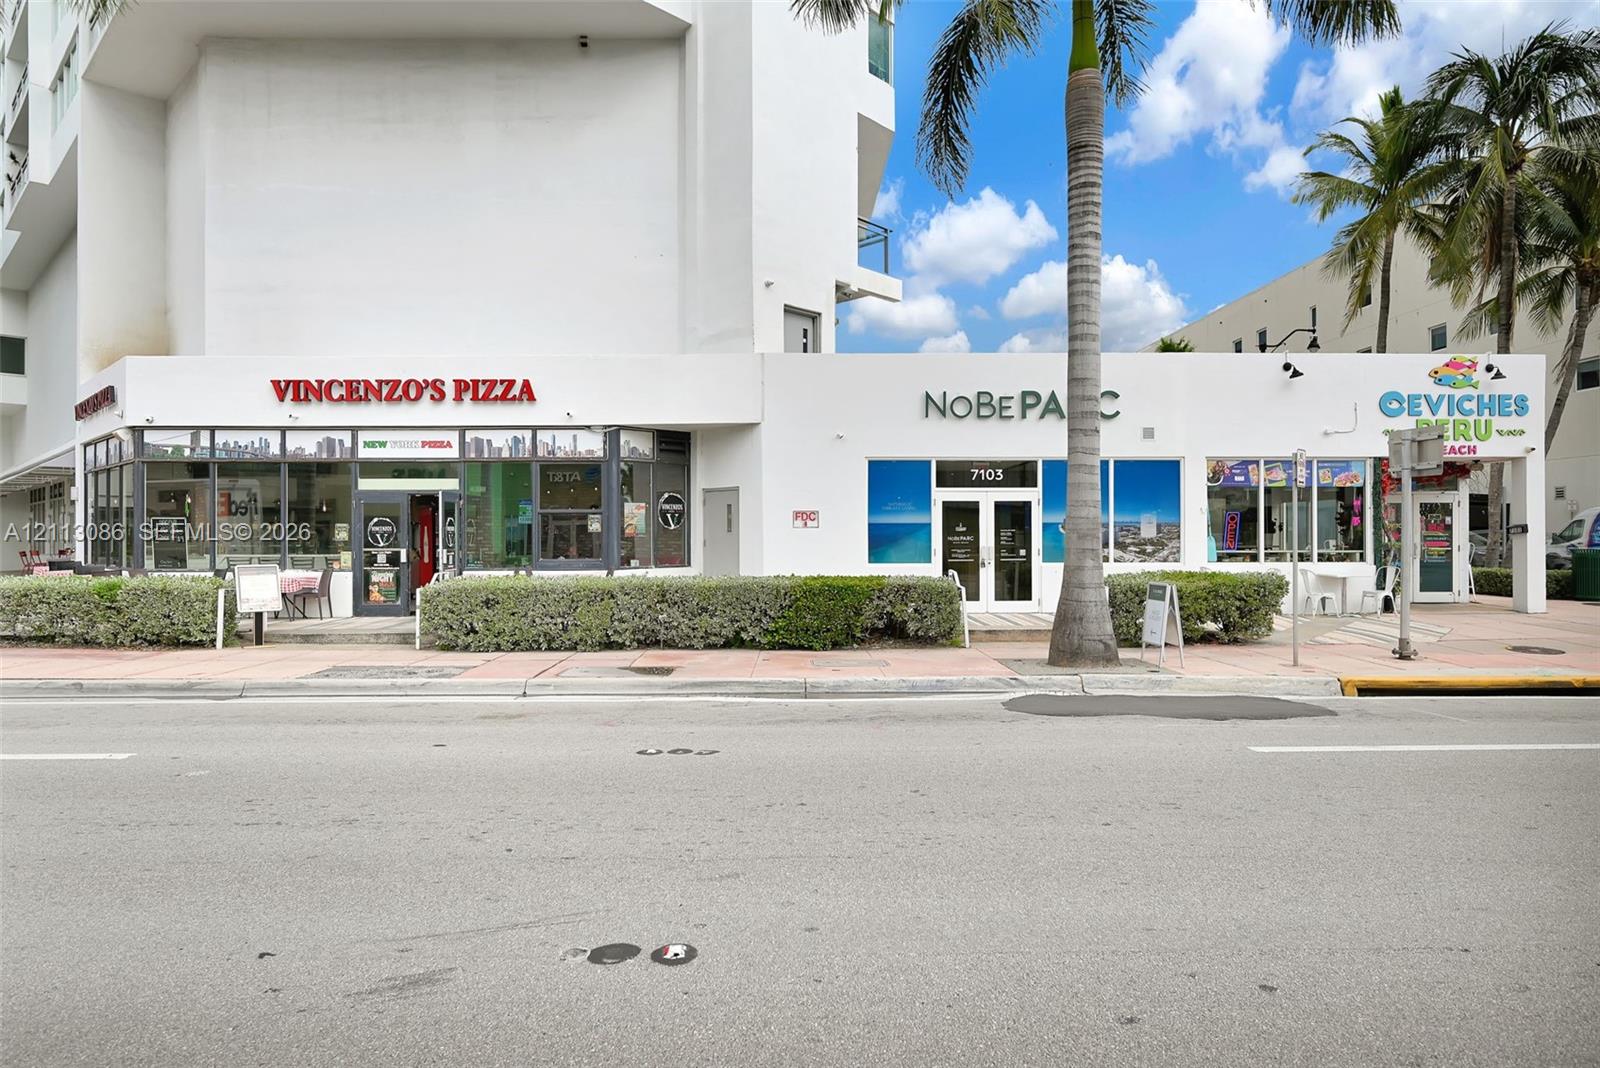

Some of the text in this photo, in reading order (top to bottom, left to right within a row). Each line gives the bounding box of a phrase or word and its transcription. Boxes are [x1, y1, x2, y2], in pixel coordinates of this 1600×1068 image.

[270, 379, 537, 402] VINCENZO'S PIZZA
[924, 390, 1121, 420] NOBEPAC
[1379, 391, 1530, 418] CEVICHES
[363, 440, 453, 449] NEW YORK PIZZA
[970, 469, 1004, 480] 7103
[795, 511, 816, 521] FDC
[1226, 514, 1238, 549] OPEN
